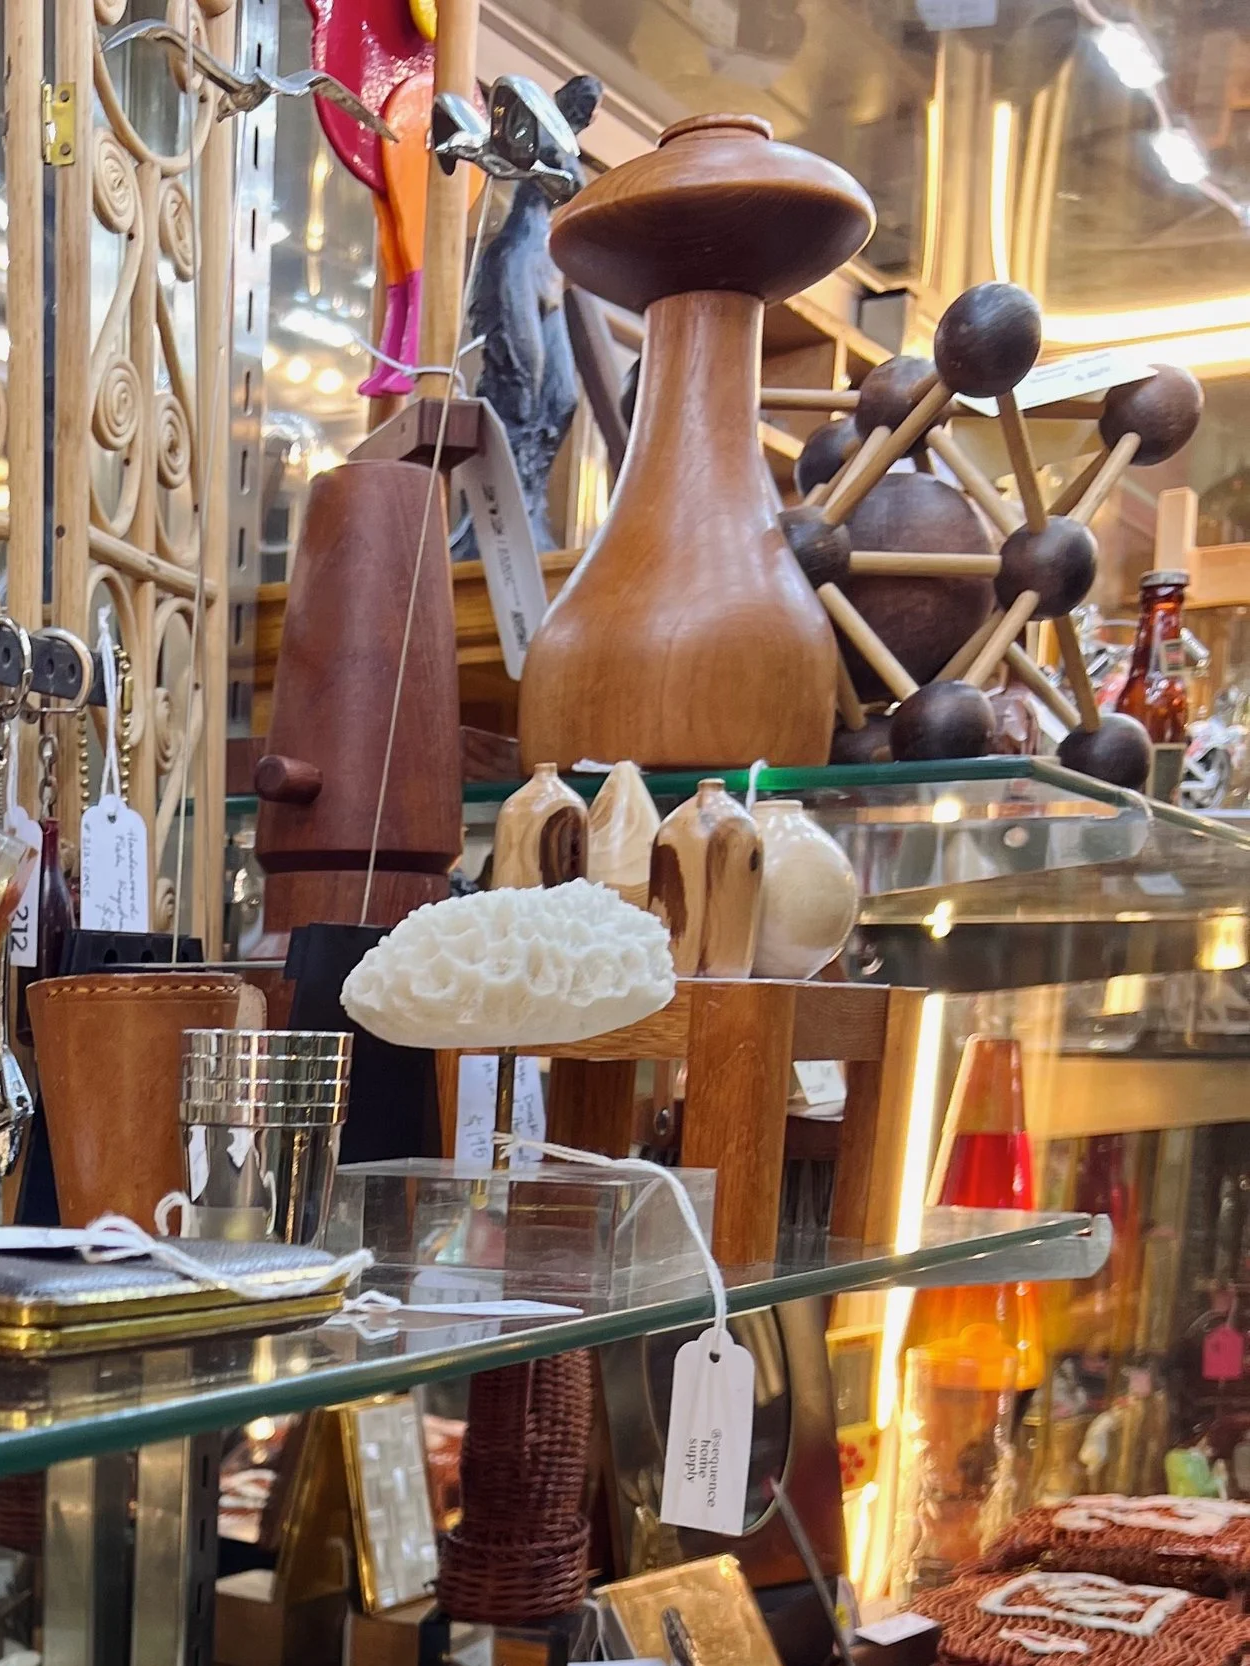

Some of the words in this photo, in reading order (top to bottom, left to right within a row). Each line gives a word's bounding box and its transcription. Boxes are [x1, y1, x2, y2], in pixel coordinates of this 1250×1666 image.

[11, 906, 30, 953] 212
[684, 1437, 698, 1484] supply
[698, 1439, 712, 1479] home
[707, 1428, 722, 1508] @sequence
